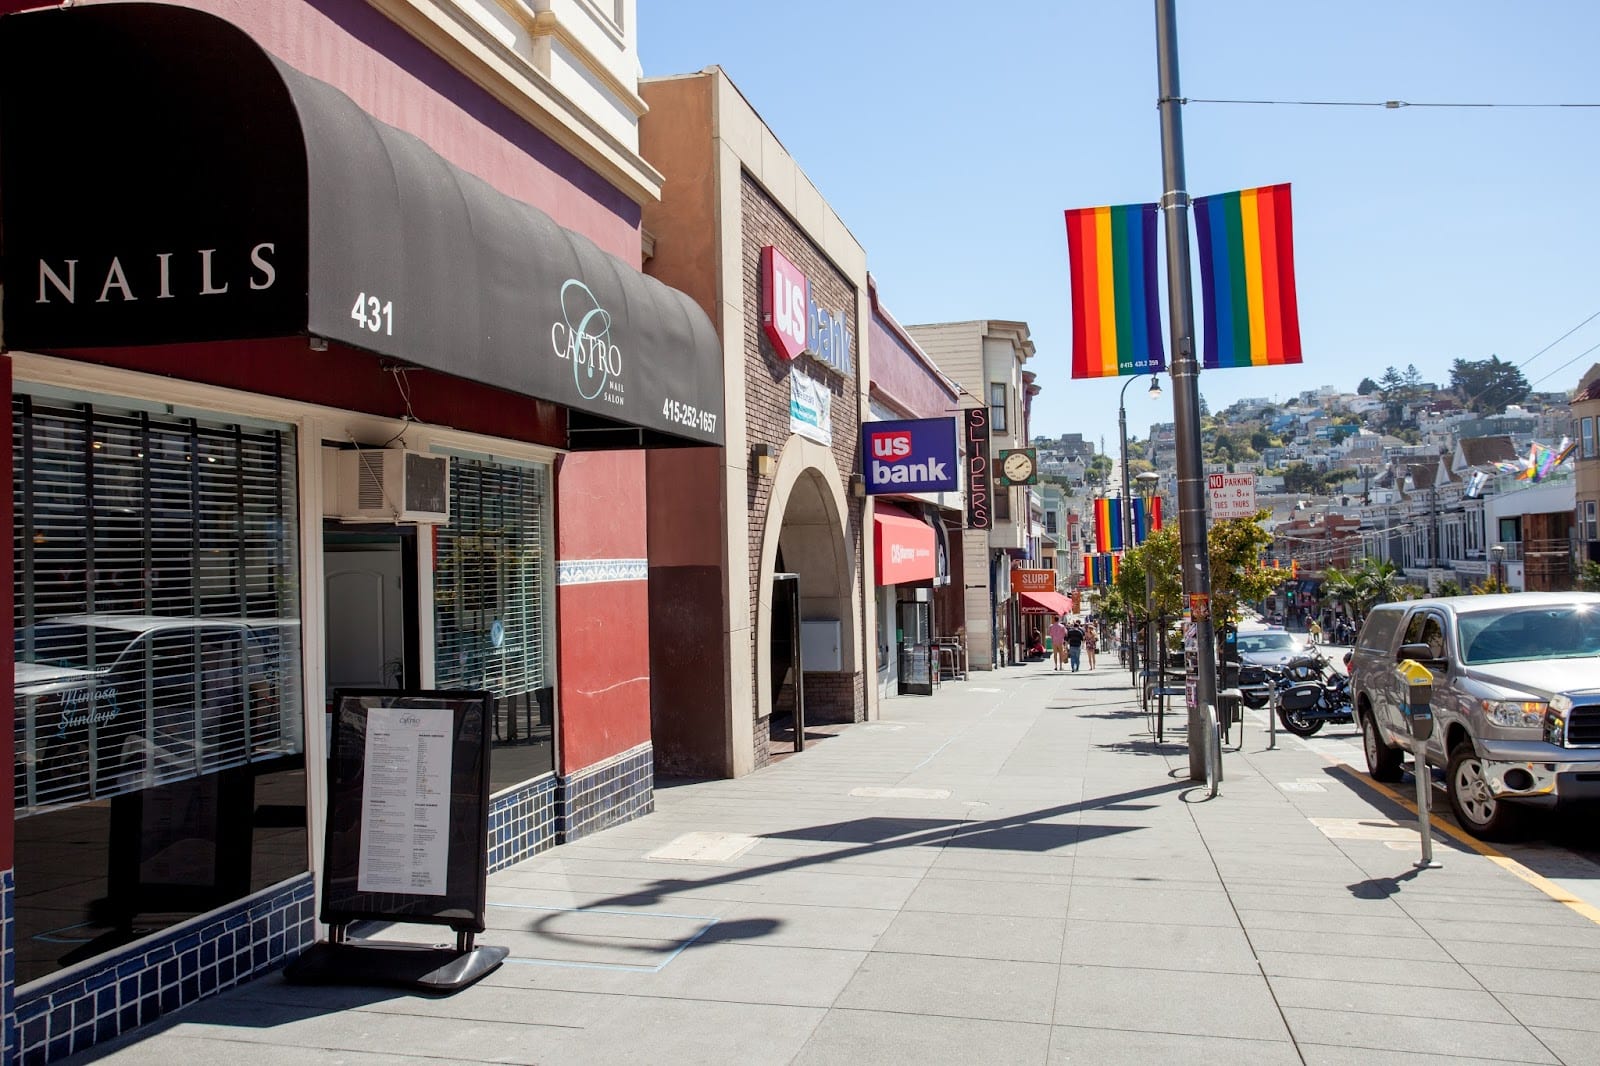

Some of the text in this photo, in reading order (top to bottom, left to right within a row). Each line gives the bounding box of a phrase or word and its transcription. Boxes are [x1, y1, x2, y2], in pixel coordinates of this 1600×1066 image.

[35, 242, 276, 304] NAILS
[351, 292, 393, 336] 431
[807, 277, 852, 377] bank
[551, 322, 622, 377] CASTRO
[604, 392, 624, 405] SALON
[610, 381, 625, 393] NAIL
[663, 398, 717, 434] 415-252-1657
[872, 457, 948, 484] bank
[970, 410, 988, 528] SLIDERS
[1210, 475, 1252, 488] NO PARKING
[1215, 500, 1249, 509] TUES THURS
[1022, 573, 1050, 584] SLURP
[57, 687, 116, 706] Mimosa
[57, 706, 116, 728] Sundays
